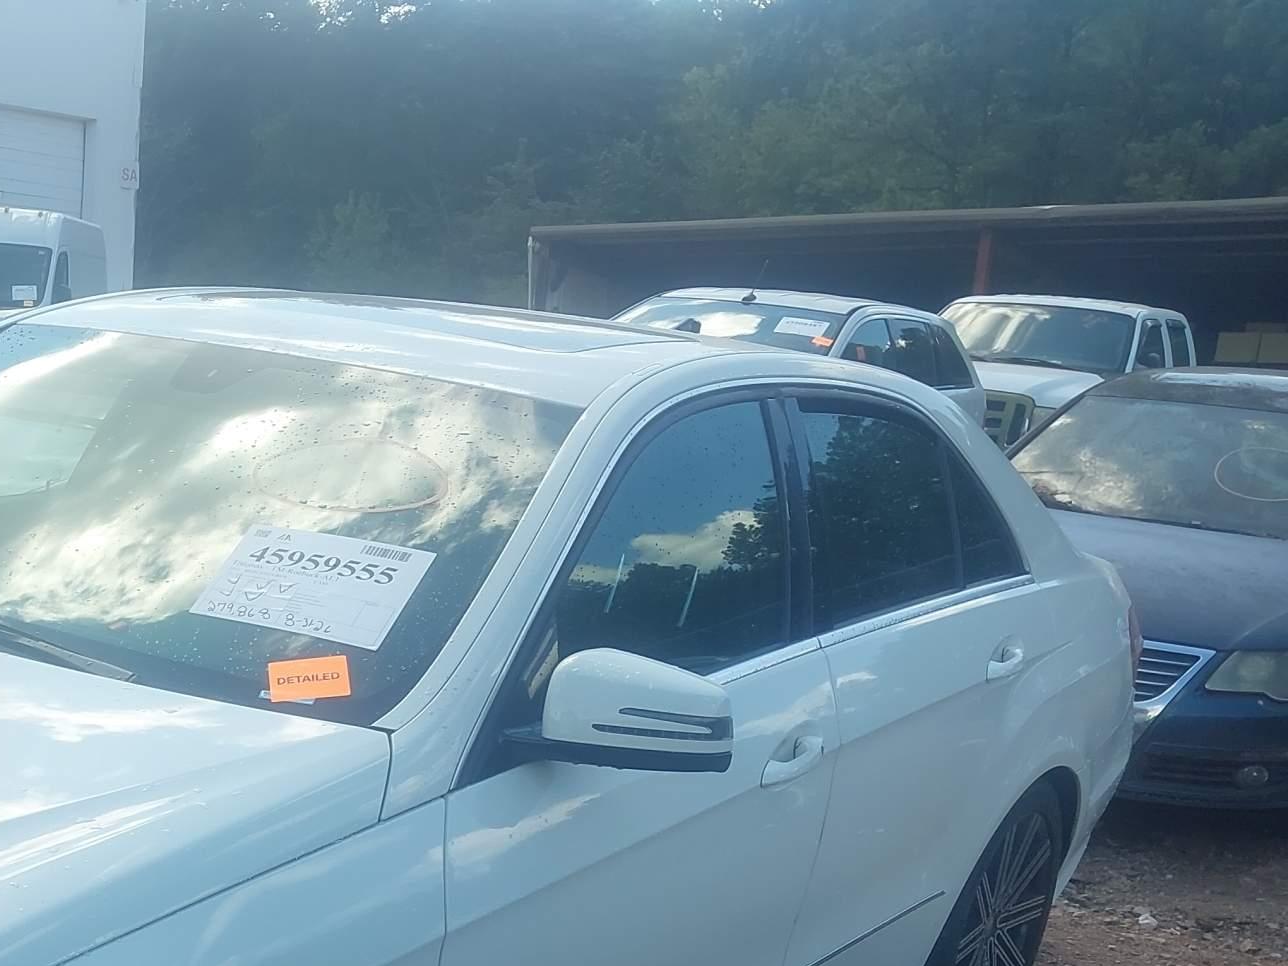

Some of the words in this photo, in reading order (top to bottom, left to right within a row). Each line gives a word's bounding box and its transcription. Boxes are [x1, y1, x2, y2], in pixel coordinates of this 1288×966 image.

[121, 167, 137, 181] SA
[249, 546, 399, 585] 45959555
[276, 671, 340, 686] DETAILED
